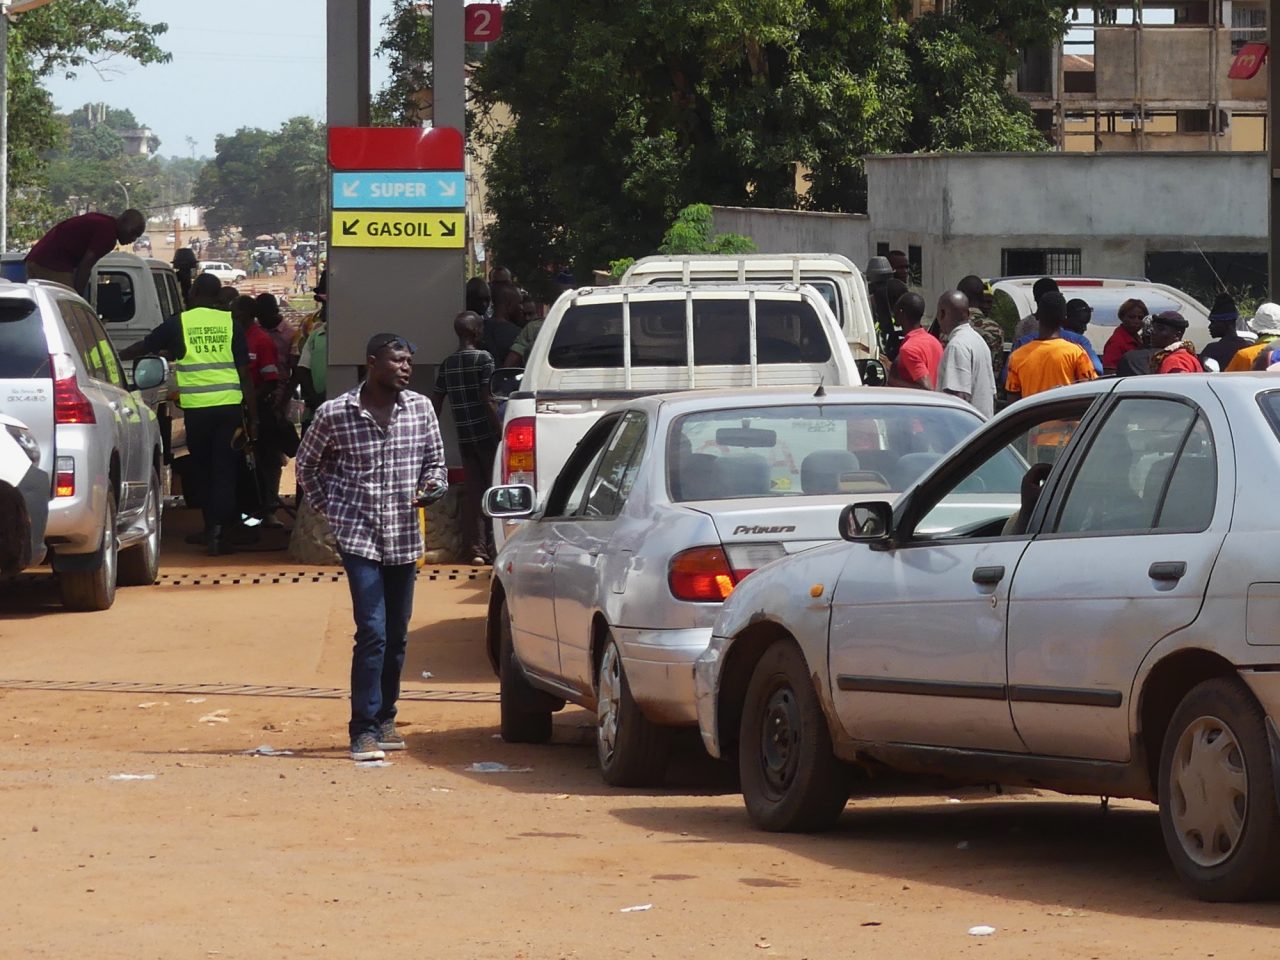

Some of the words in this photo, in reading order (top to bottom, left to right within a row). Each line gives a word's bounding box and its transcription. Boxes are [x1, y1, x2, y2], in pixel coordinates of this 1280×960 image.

[474, 9, 491, 35] 2
[370, 182, 427, 197] SUPER
[366, 222, 432, 237] GASOIL
